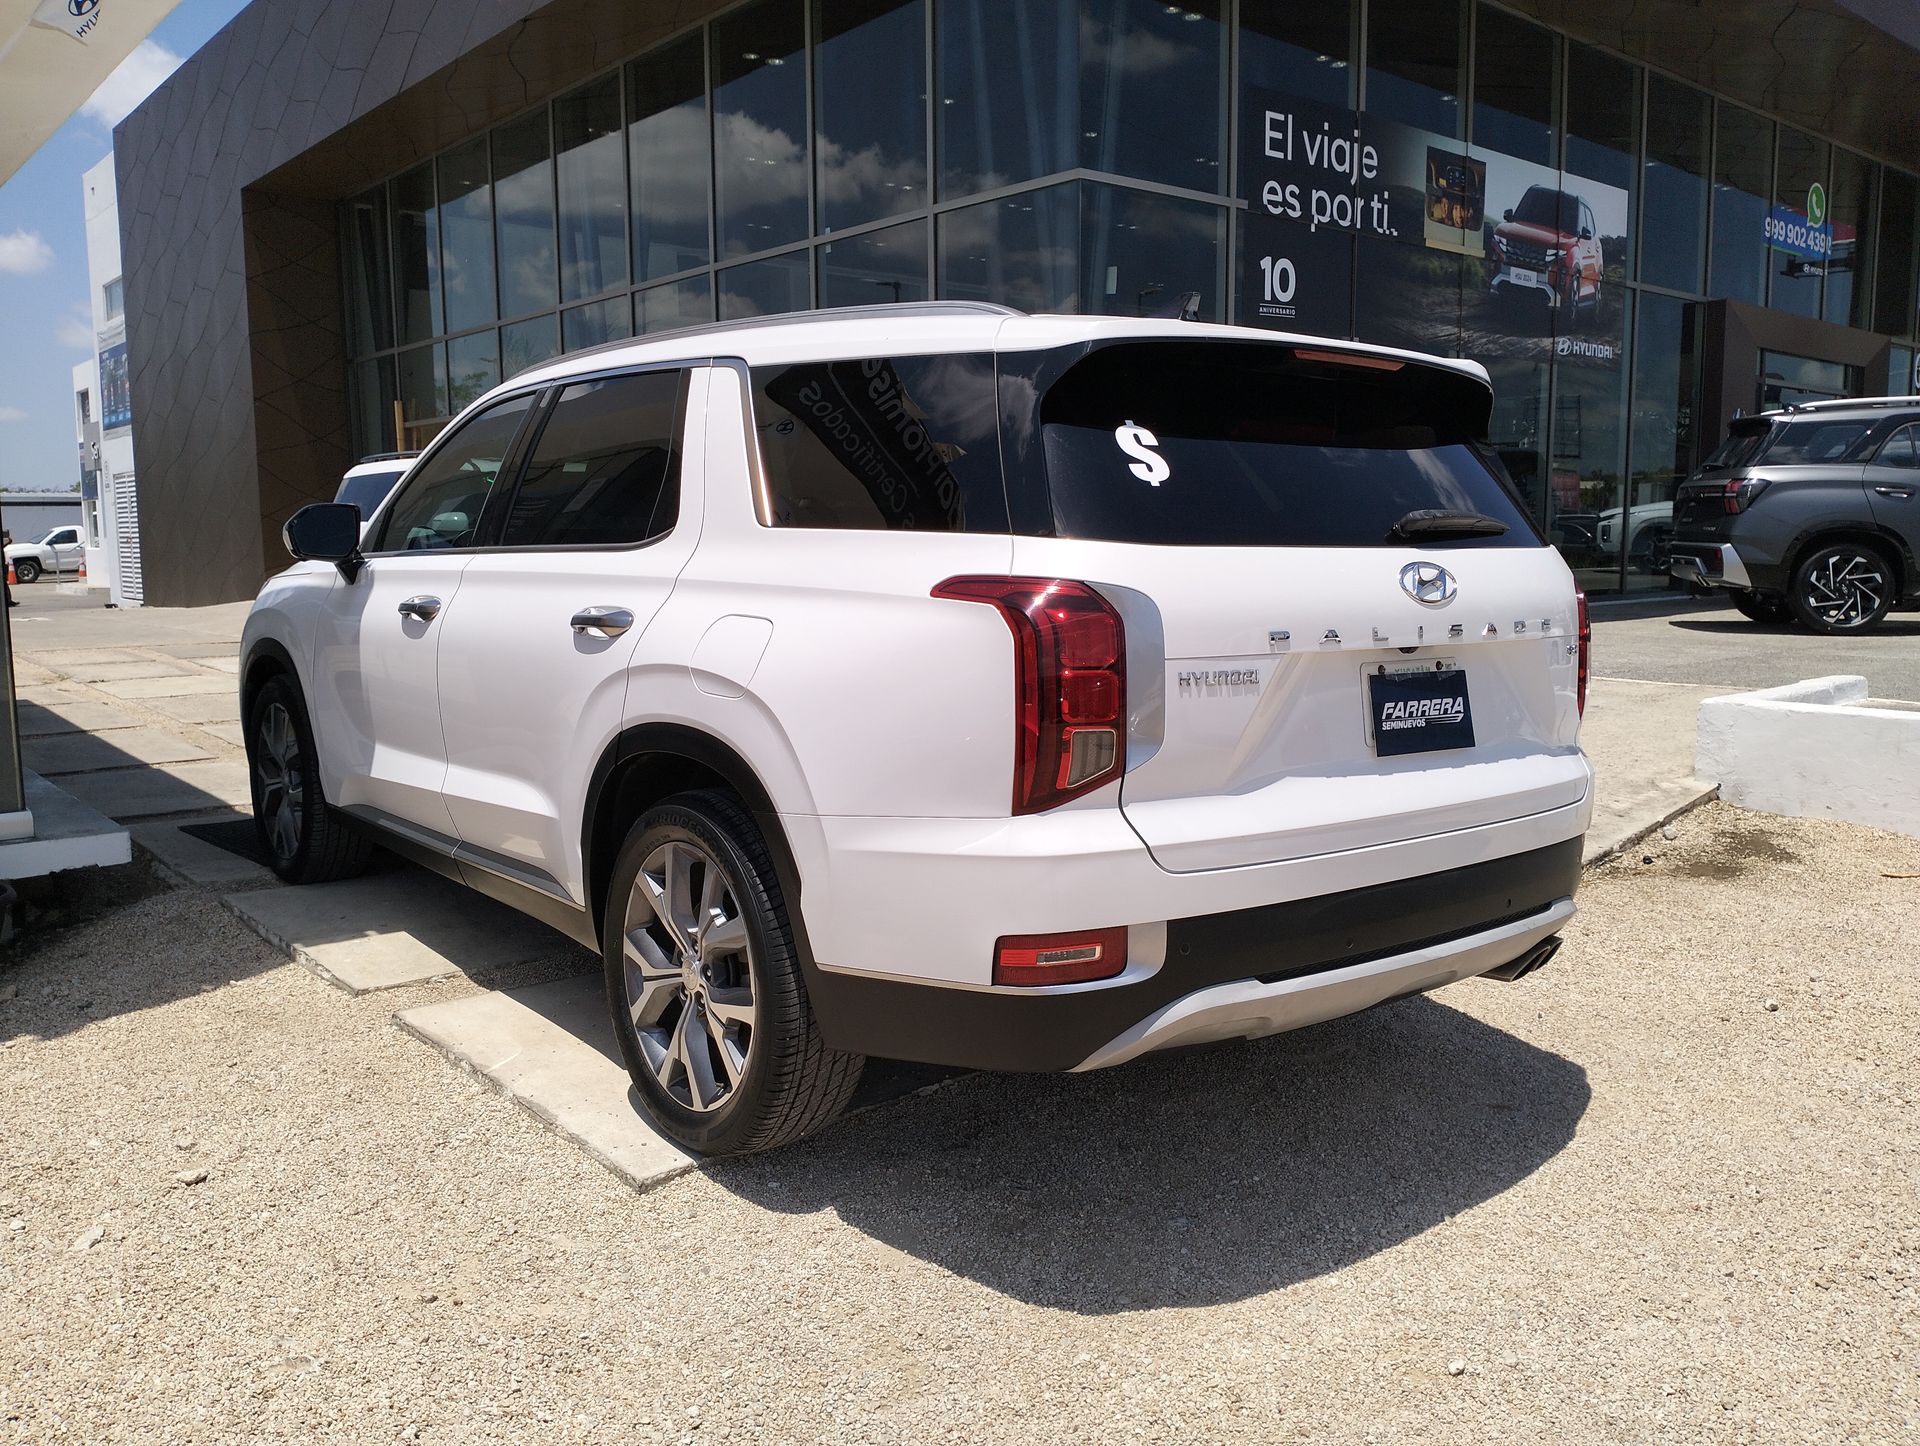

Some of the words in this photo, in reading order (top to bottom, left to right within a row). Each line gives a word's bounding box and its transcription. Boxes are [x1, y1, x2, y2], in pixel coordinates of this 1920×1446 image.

[1265, 110, 1293, 161] El
[1302, 122, 1378, 186] viaje
[1262, 180, 1302, 218] es
[1311, 189, 1365, 232] por
[1370, 191, 1398, 236] ti.
[1787, 224, 1807, 248] 902
[1259, 256, 1296, 302] 10
[1259, 307, 1296, 315] ANIVERSARIO
[1573, 341, 1613, 359] HYUNDAI
[1268, 619, 1552, 647] PALISADE
[1178, 668, 1260, 686] HYUNDAI
[1382, 697, 1464, 719] FARRERA
[1382, 718, 1426, 731] SEMINUEVOS
